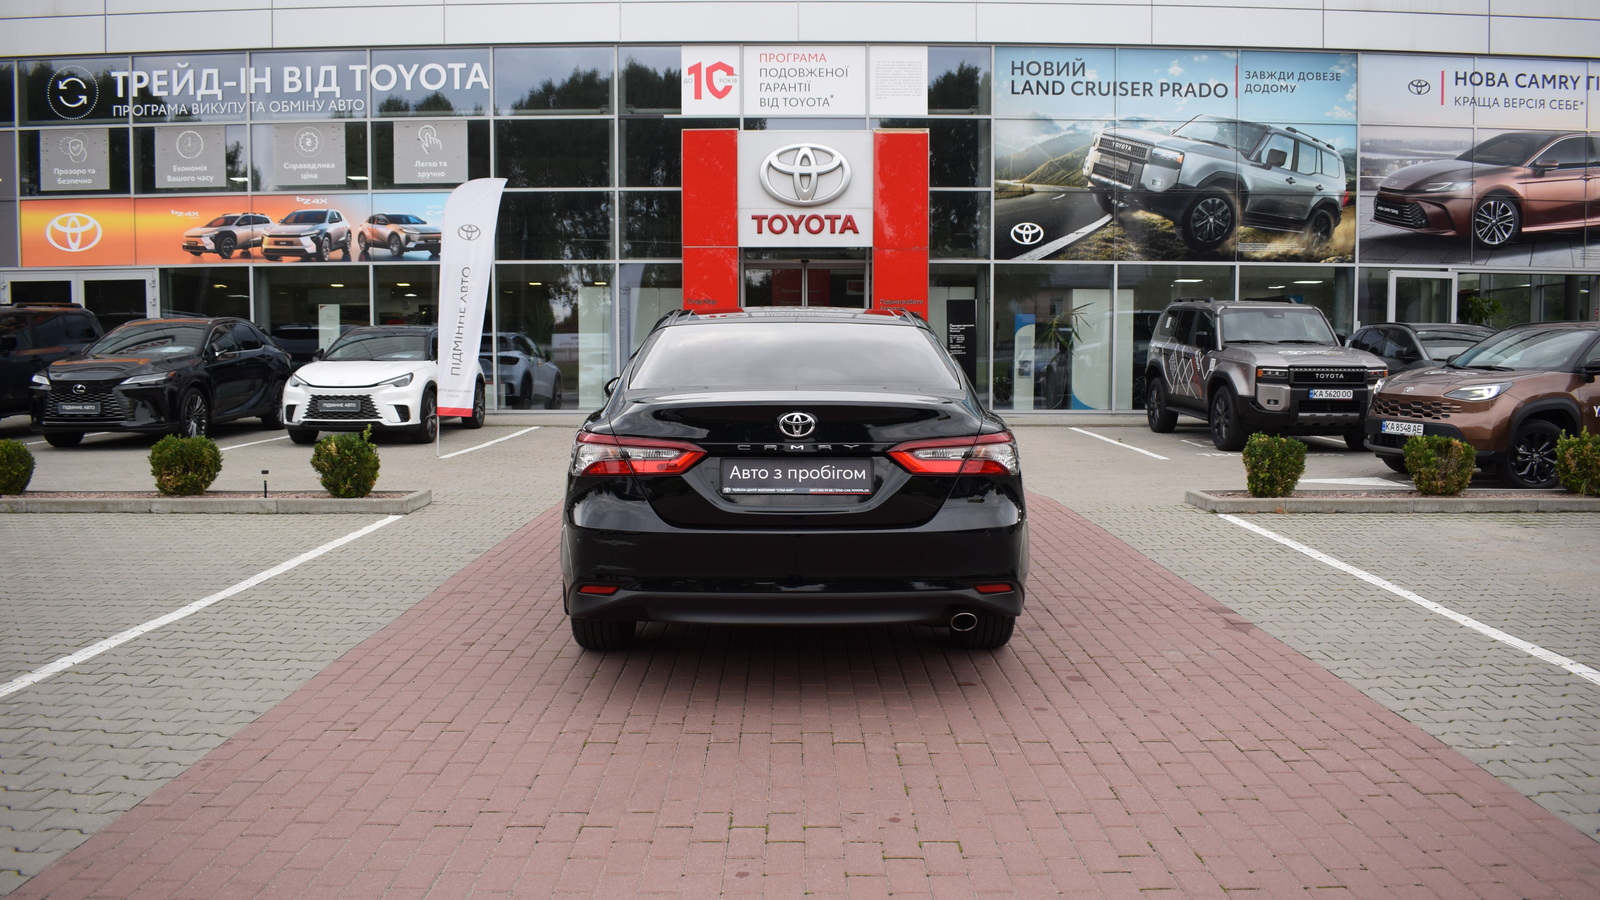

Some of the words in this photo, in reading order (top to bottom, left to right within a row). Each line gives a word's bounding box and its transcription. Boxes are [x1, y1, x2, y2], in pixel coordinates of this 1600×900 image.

[759, 53, 827, 63] ПРОГРАМА
[759, 66, 849, 78] ПОДОВЖЕНОЇ
[1011, 57, 1086, 76] НОВИЙ
[111, 63, 271, 101] ТРЕЙД-ІН
[283, 65, 340, 98] ВІД
[349, 62, 490, 91] TOYOTA
[1245, 71, 1294, 81] ЗАВЖДИ
[1297, 71, 1341, 82] ДОВЕЗЕ
[1455, 71, 1509, 88] НОВА
[1515, 73, 1580, 90] CAMRY
[759, 81, 811, 93] ГАРАНТІЇ
[1011, 80, 1065, 95] LAND
[1071, 81, 1153, 97] CRUISER
[1160, 82, 1228, 98] PRADO
[1244, 84, 1296, 94] ДОДОМУ
[113, 102, 188, 117] ПРОГРАМА
[192, 101, 247, 115] ВИКУПУ
[249, 101, 265, 113] ТА
[269, 99, 325, 113] ОБМІНУ
[330, 98, 365, 111] АВТО
[759, 97, 780, 109] ВІД
[1454, 96, 1500, 109] КРАЩА
[1504, 98, 1545, 109] ВЕРСІЯ
[172, 164, 208, 172] Економія
[283, 162, 336, 170] Справедлива
[414, 160, 438, 168] Легко
[53, 168, 87, 176] Прозоро
[300, 171, 318, 180] ціна
[416, 171, 446, 179] зручно
[196, 175, 214, 183] часу
[751, 214, 859, 234] TOYOTA
[450, 307, 467, 377] ПІДМІННЕ
[460, 266, 471, 303] АВТО
[1313, 390, 1324, 398] KA
[1325, 390, 1340, 398] 5620
[1385, 422, 1395, 431] KA
[729, 465, 769, 479] Авто
[773, 468, 783, 479] з
[788, 465, 866, 482] пробігом
